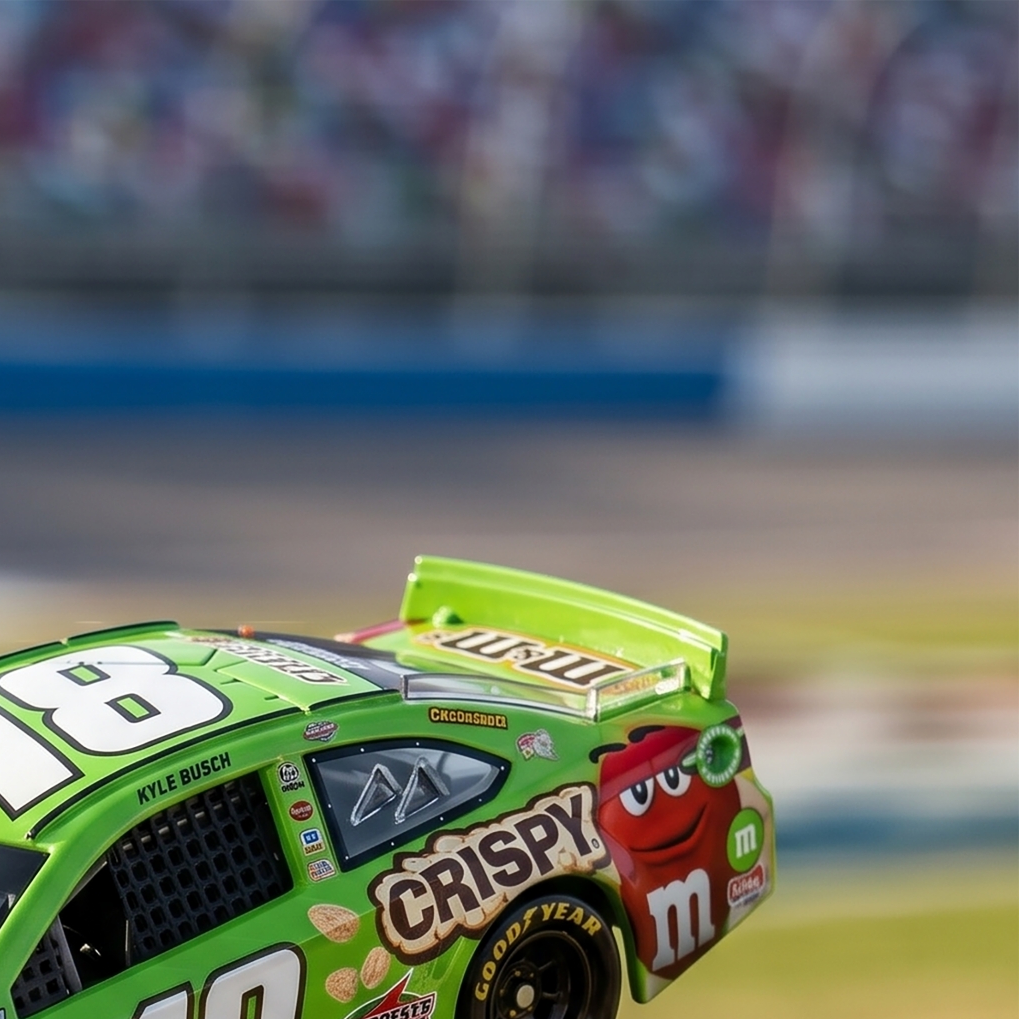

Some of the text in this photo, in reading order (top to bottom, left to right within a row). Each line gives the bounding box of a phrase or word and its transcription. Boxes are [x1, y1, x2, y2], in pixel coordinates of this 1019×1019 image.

[137, 751, 231, 805] KYLE BUSCH
[386, 792, 595, 942] CRISPY
[734, 823, 758, 859] m
[474, 902, 602, 1002] GOODYEAR
[645, 867, 715, 972] m
